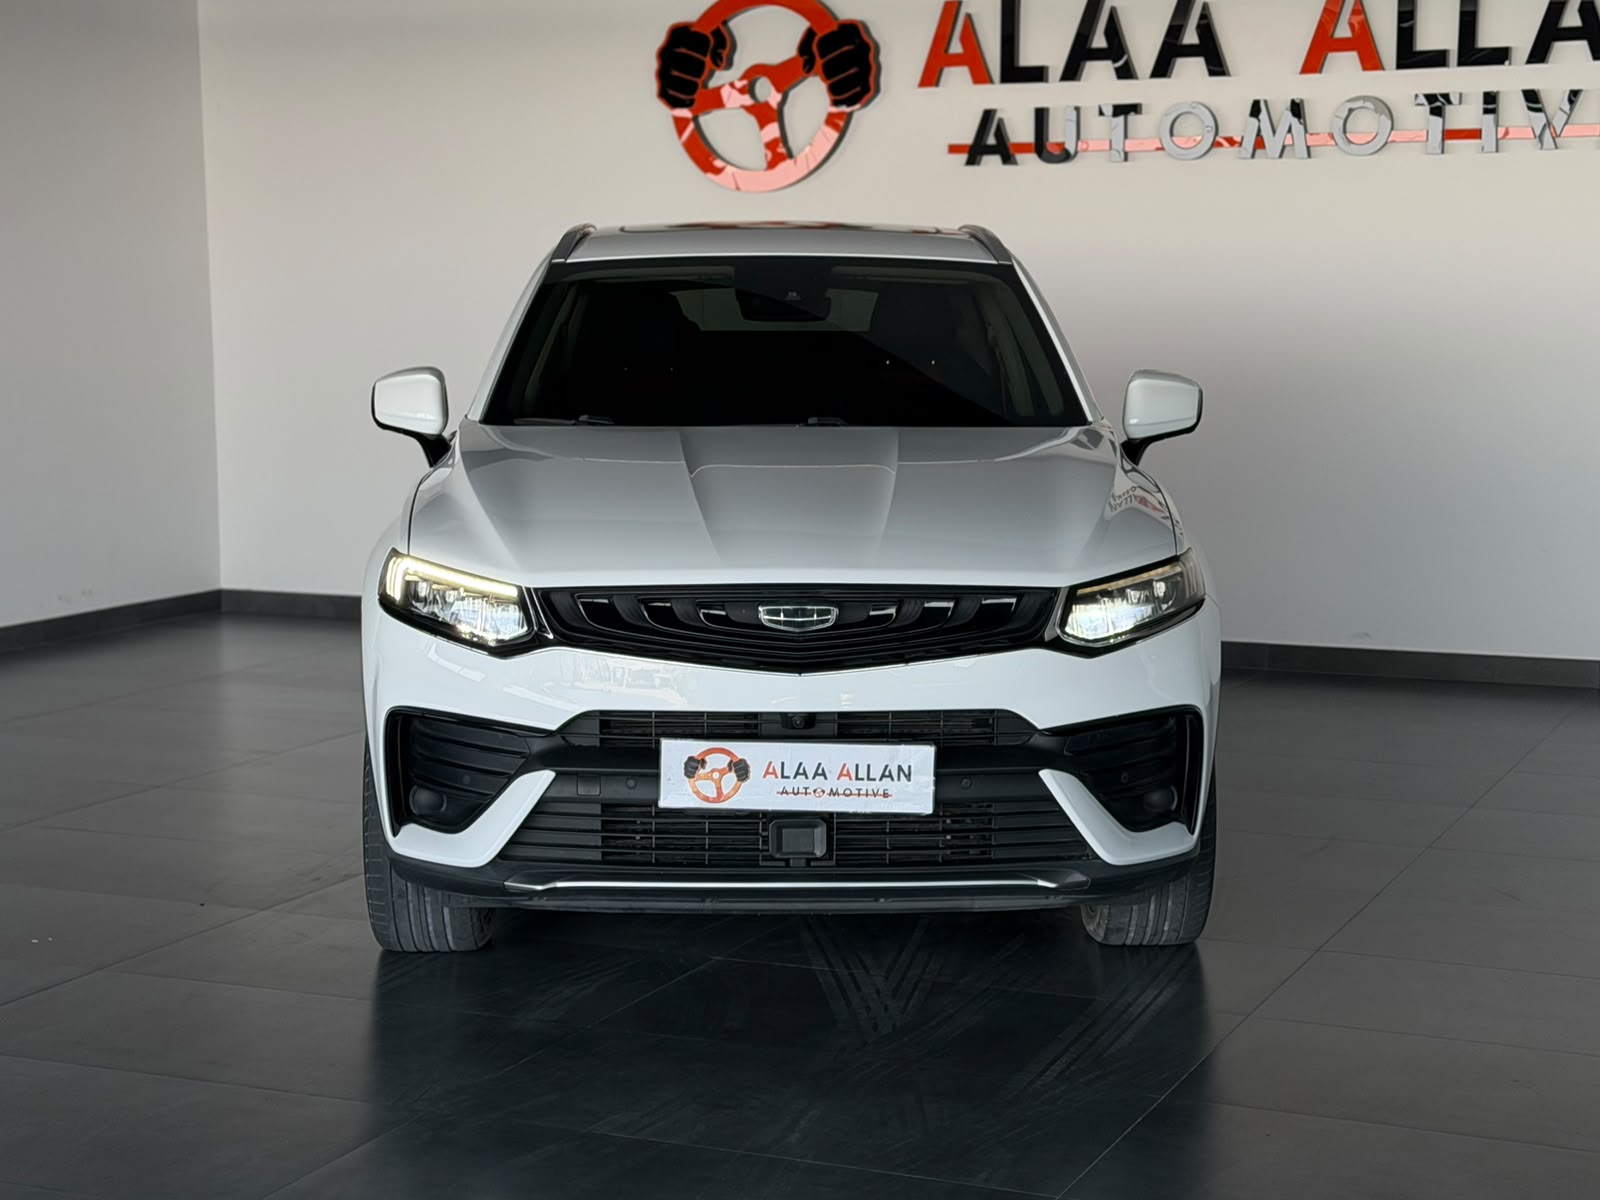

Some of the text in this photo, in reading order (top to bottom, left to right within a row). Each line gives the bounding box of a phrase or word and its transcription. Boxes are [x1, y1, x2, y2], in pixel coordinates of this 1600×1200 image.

[918, 0, 1231, 88] ALAA
[964, 88, 1584, 166] AUTOMOTIV
[762, 760, 912, 782] ALAA ALLAN
